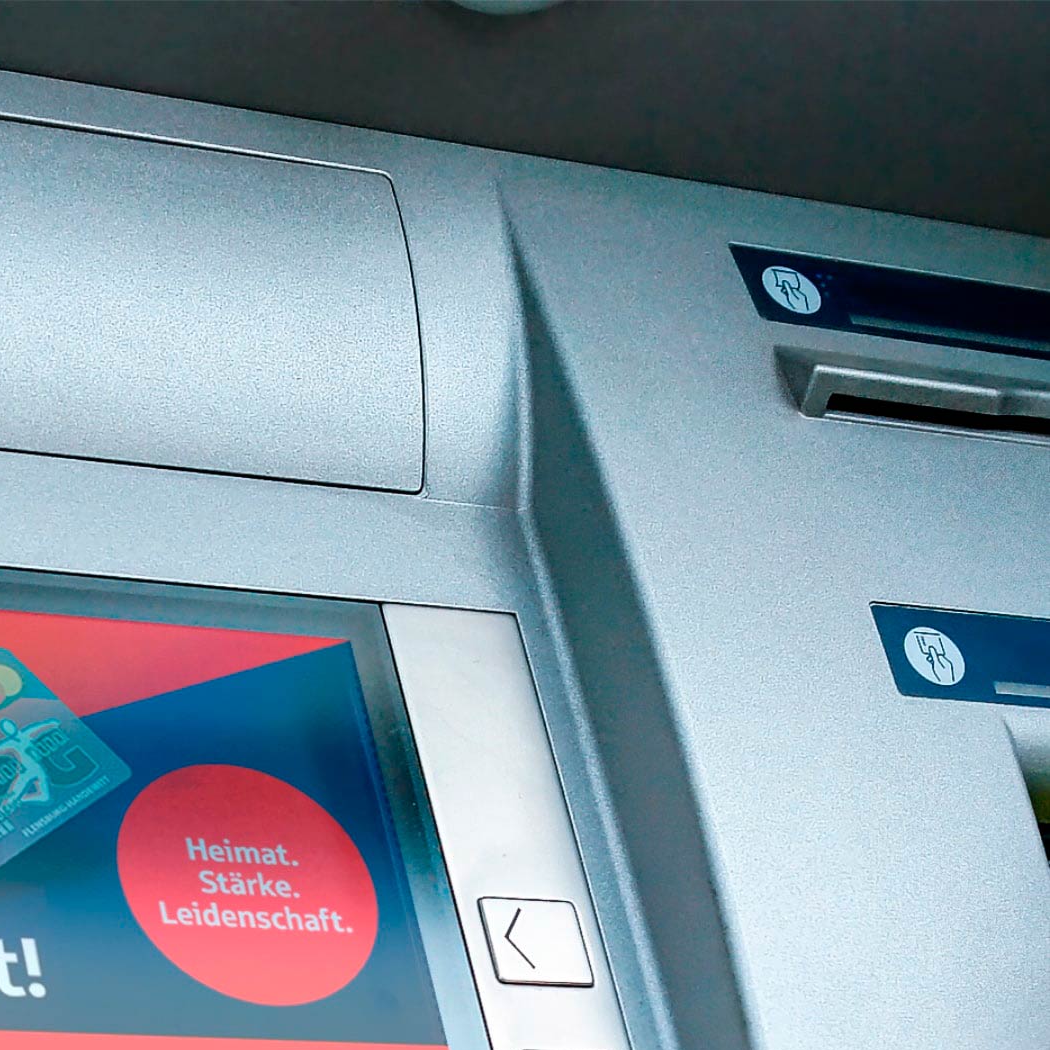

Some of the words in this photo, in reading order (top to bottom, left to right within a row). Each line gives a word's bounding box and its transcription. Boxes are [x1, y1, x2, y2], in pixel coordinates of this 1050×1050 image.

[185, 837, 299, 867] Heimat.
[199, 870, 300, 898] Stärke.
[158, 901, 354, 933] Leidenschaft.
